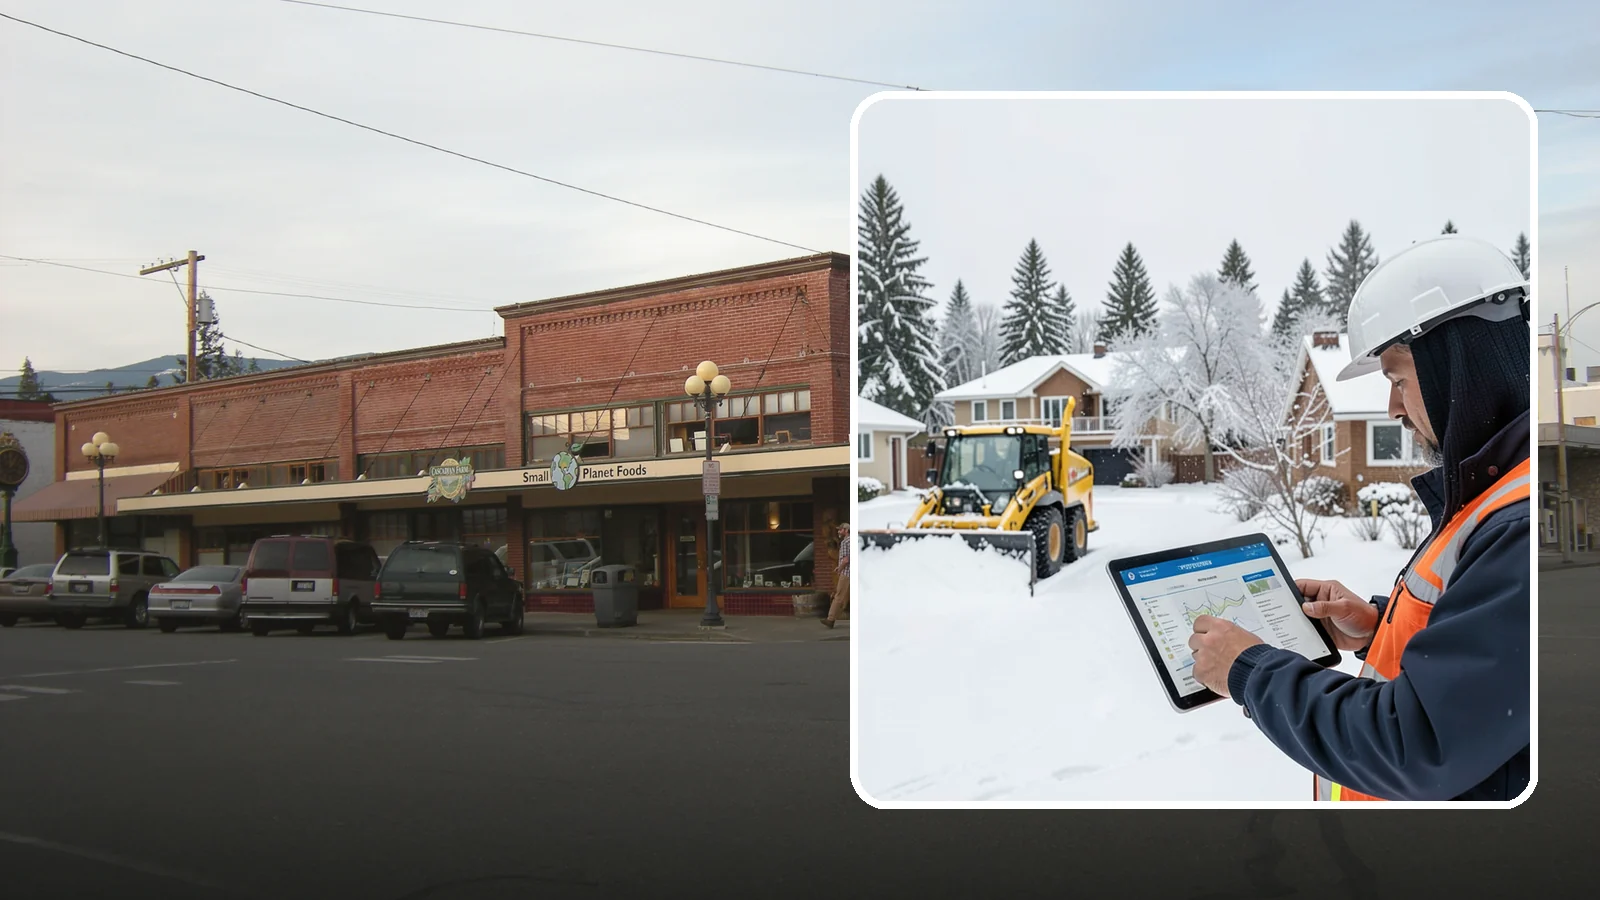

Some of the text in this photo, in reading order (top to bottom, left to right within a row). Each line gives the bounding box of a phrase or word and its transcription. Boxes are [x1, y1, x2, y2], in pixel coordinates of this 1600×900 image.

[431, 465, 469, 476] CASCADIAN FARM
[523, 464, 647, 483] Small Planet Foods
